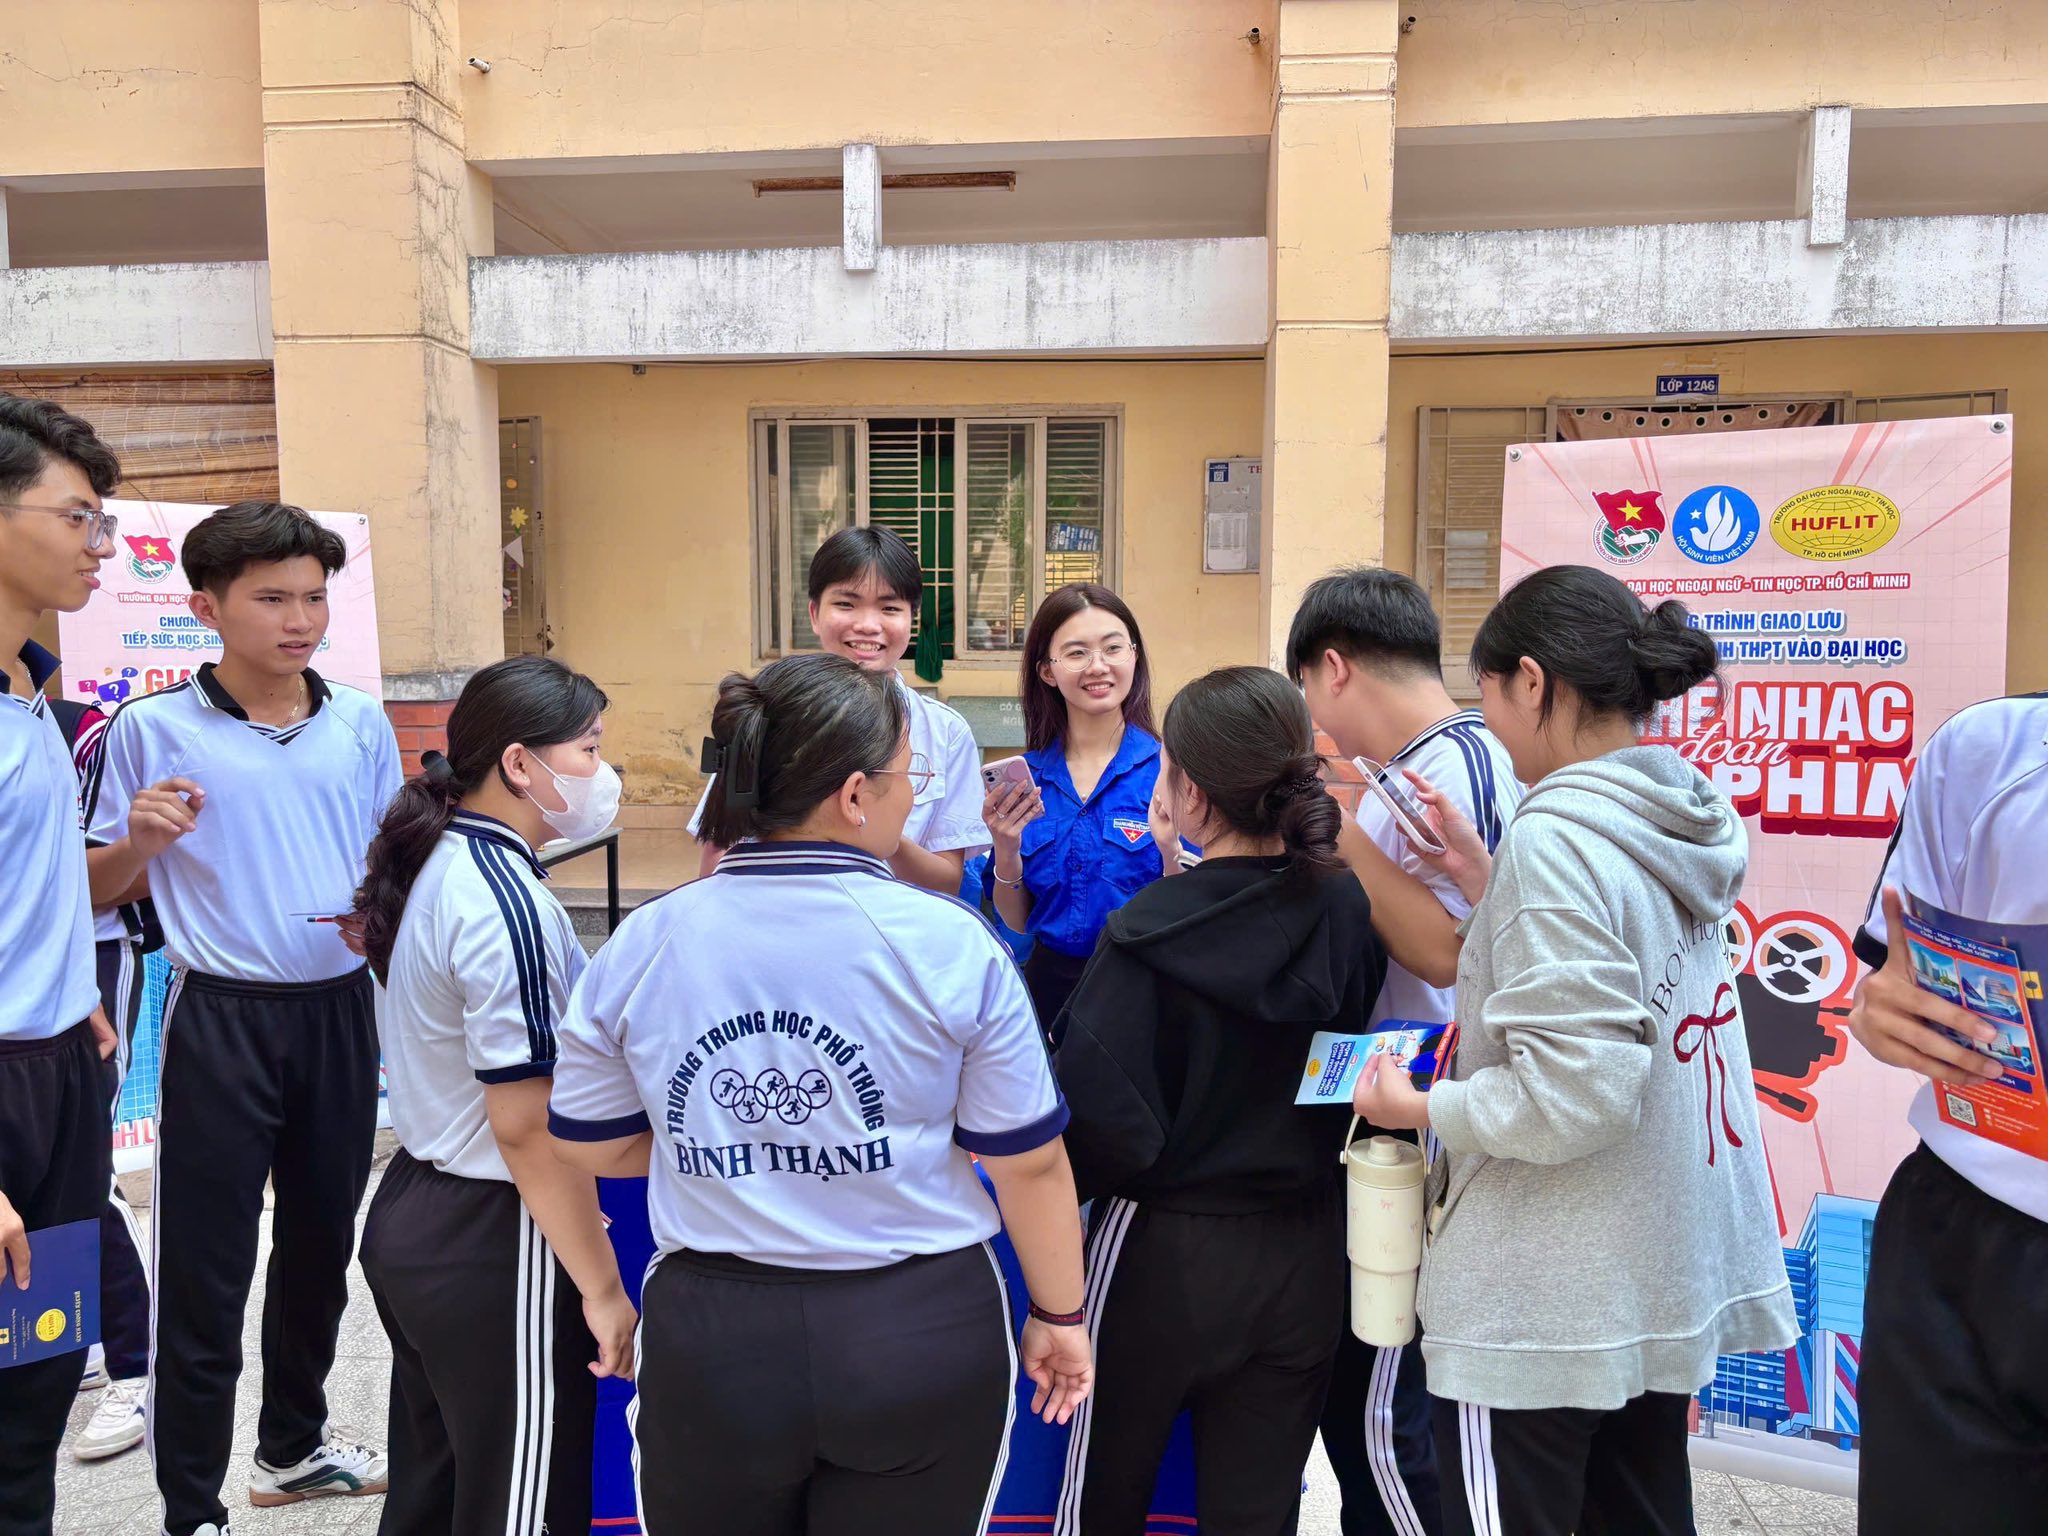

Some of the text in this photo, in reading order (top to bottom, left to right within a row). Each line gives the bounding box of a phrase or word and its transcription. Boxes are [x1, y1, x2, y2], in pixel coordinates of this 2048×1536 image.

[1660, 378, 1715, 392] LỚP 12A6
[1774, 500, 1796, 524] TRƯỜNG
[1796, 495, 1809, 504] ĐẠI
[1810, 490, 1827, 498] HỌC
[1853, 489, 1870, 498] NGỮ
[1875, 497, 1887, 508] TIN
[1884, 505, 1896, 520] HỌC
[1791, 514, 1879, 532] HUFLIT
[1676, 531, 1756, 563] HỘI SINH VIÊN VIỆT NAM
[1815, 549, 1827, 558] HỒ
[1828, 549, 1842, 558] CHÍ
[1843, 547, 1863, 557] MINH
[1649, 580, 1673, 595] HỌC
[1676, 579, 1713, 595] NGOẠI
[1716, 576, 1743, 593] NGỮ
[1753, 578, 1773, 591] TIN
[1777, 578, 1802, 593] HỌC
[1804, 577, 1823, 590] TP.
[1847, 573, 1871, 589] CHÍ
[1873, 574, 1909, 588] MINH
[153, 594, 167, 605] ĐẠI
[170, 595, 186, 605] HỌC
[1704, 610, 1755, 630] TRÌNH
[1760, 613, 1801, 630] GIAO
[1808, 610, 1842, 629] LƯU
[122, 630, 147, 645] TIẾP
[151, 632, 174, 645] SỨC
[177, 634, 200, 647] HỌC
[1740, 641, 1782, 658] THPT
[1787, 636, 1822, 658] VÀO
[1828, 640, 1859, 663] ĐẠI
[1864, 639, 1902, 662] HỌC
[1739, 686, 1908, 754] NHẠC
[1678, 721, 1791, 765] đoán
[665, 1009, 886, 1135] TRƯỜNG TRUNG HỌC PHỔ THÔNG
[673, 1135, 895, 1182] BÌNH THẠNH
